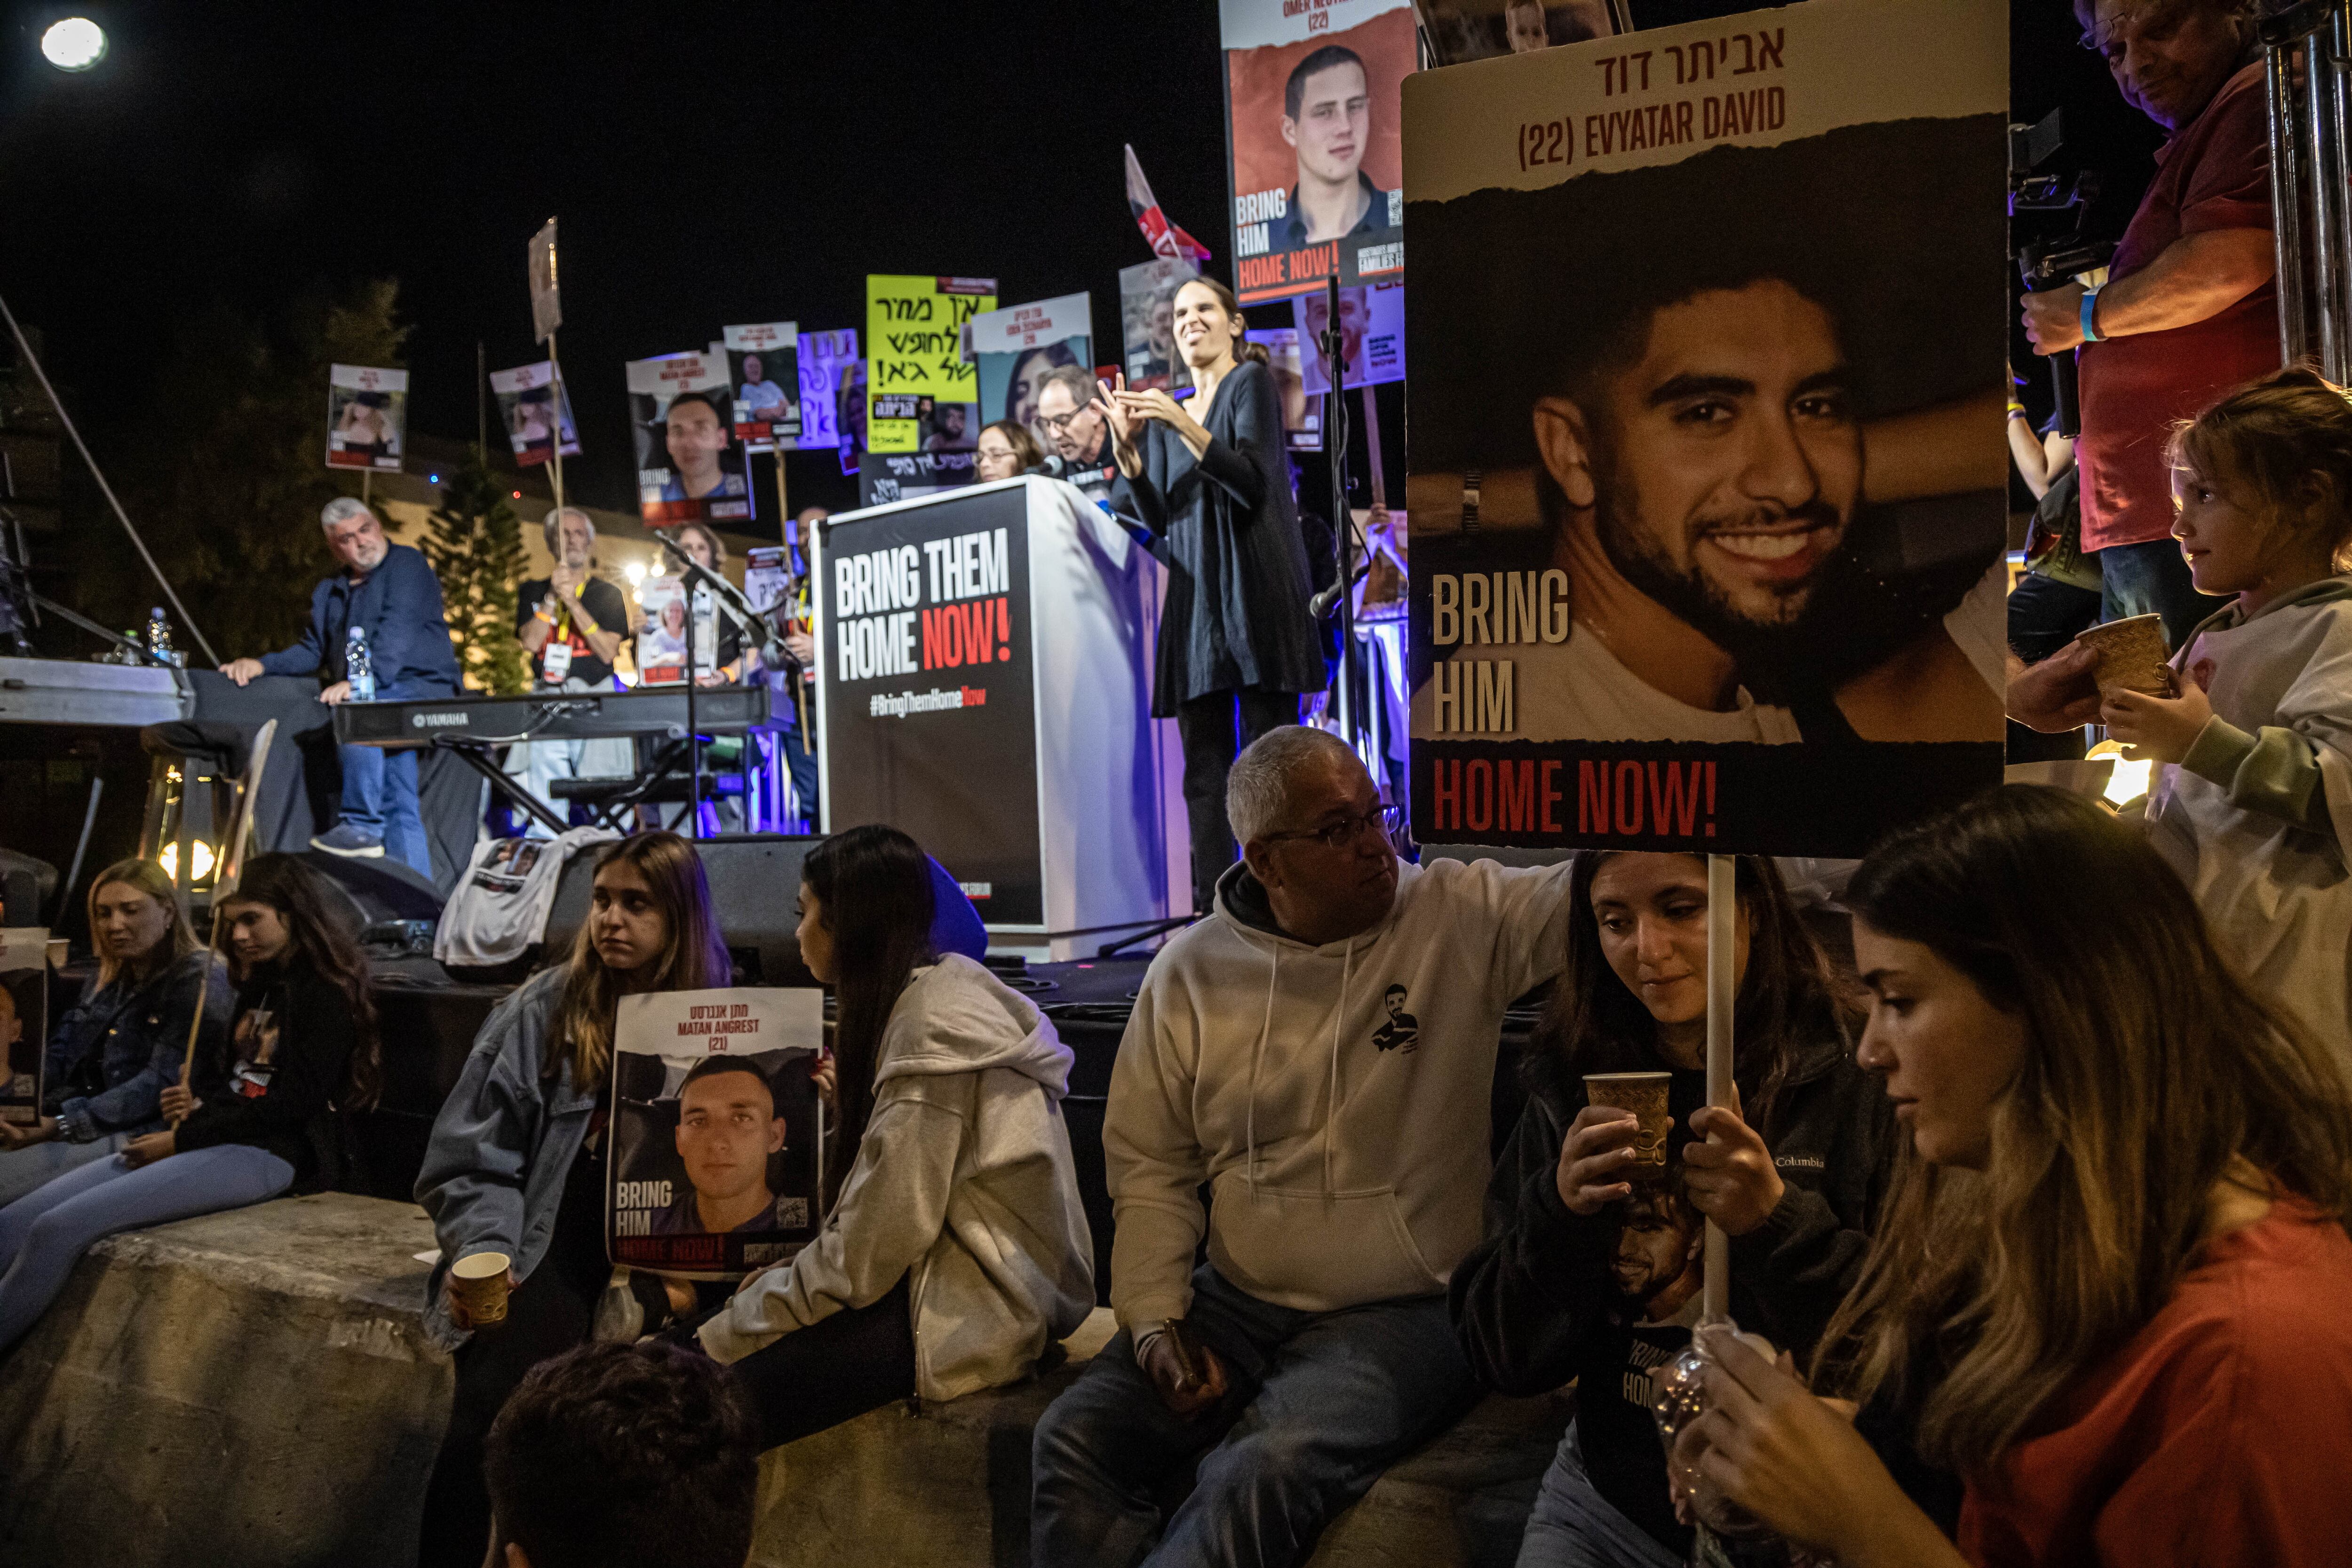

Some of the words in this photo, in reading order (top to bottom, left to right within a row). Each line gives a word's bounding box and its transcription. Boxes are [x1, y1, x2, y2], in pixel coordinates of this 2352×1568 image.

[1308, 9, 1328, 32] (22)
[1595, 50, 1653, 96] דוד
[1665, 28, 1785, 84] אביתר
[1518, 117, 1574, 172] (22)
[1585, 101, 1693, 157] EVYATAR
[1703, 87, 1785, 140] DAVID
[1235, 188, 1286, 226] BRING
[1236, 222, 1270, 257] HIM
[1239, 253, 1286, 289] HOME
[1289, 239, 1340, 280] NOW!
[876, 297, 932, 321] מחיר
[949, 296, 979, 327] אין
[887, 325, 958, 354] לחופש
[835, 544, 921, 618] BRING
[923, 527, 1009, 603] THEM
[1433, 569, 1568, 645] BRING
[837, 611, 918, 681] HOME
[922, 597, 1011, 670] NOW!
[870, 685, 986, 718] #BringThemHomeNow
[1433, 661, 1513, 732] HIM
[425, 712, 469, 727] YAMAHA
[1434, 759, 1563, 833] HOME
[1578, 760, 1716, 837] NOW!
[677, 1021, 713, 1036] MATAN
[715, 1019, 760, 1034] ANGREST
[708, 1035, 728, 1051] (21)
[1776, 1157, 1824, 1168] Columbia
[616, 1180, 673, 1210] BRING
[615, 1210, 651, 1237] HIM
